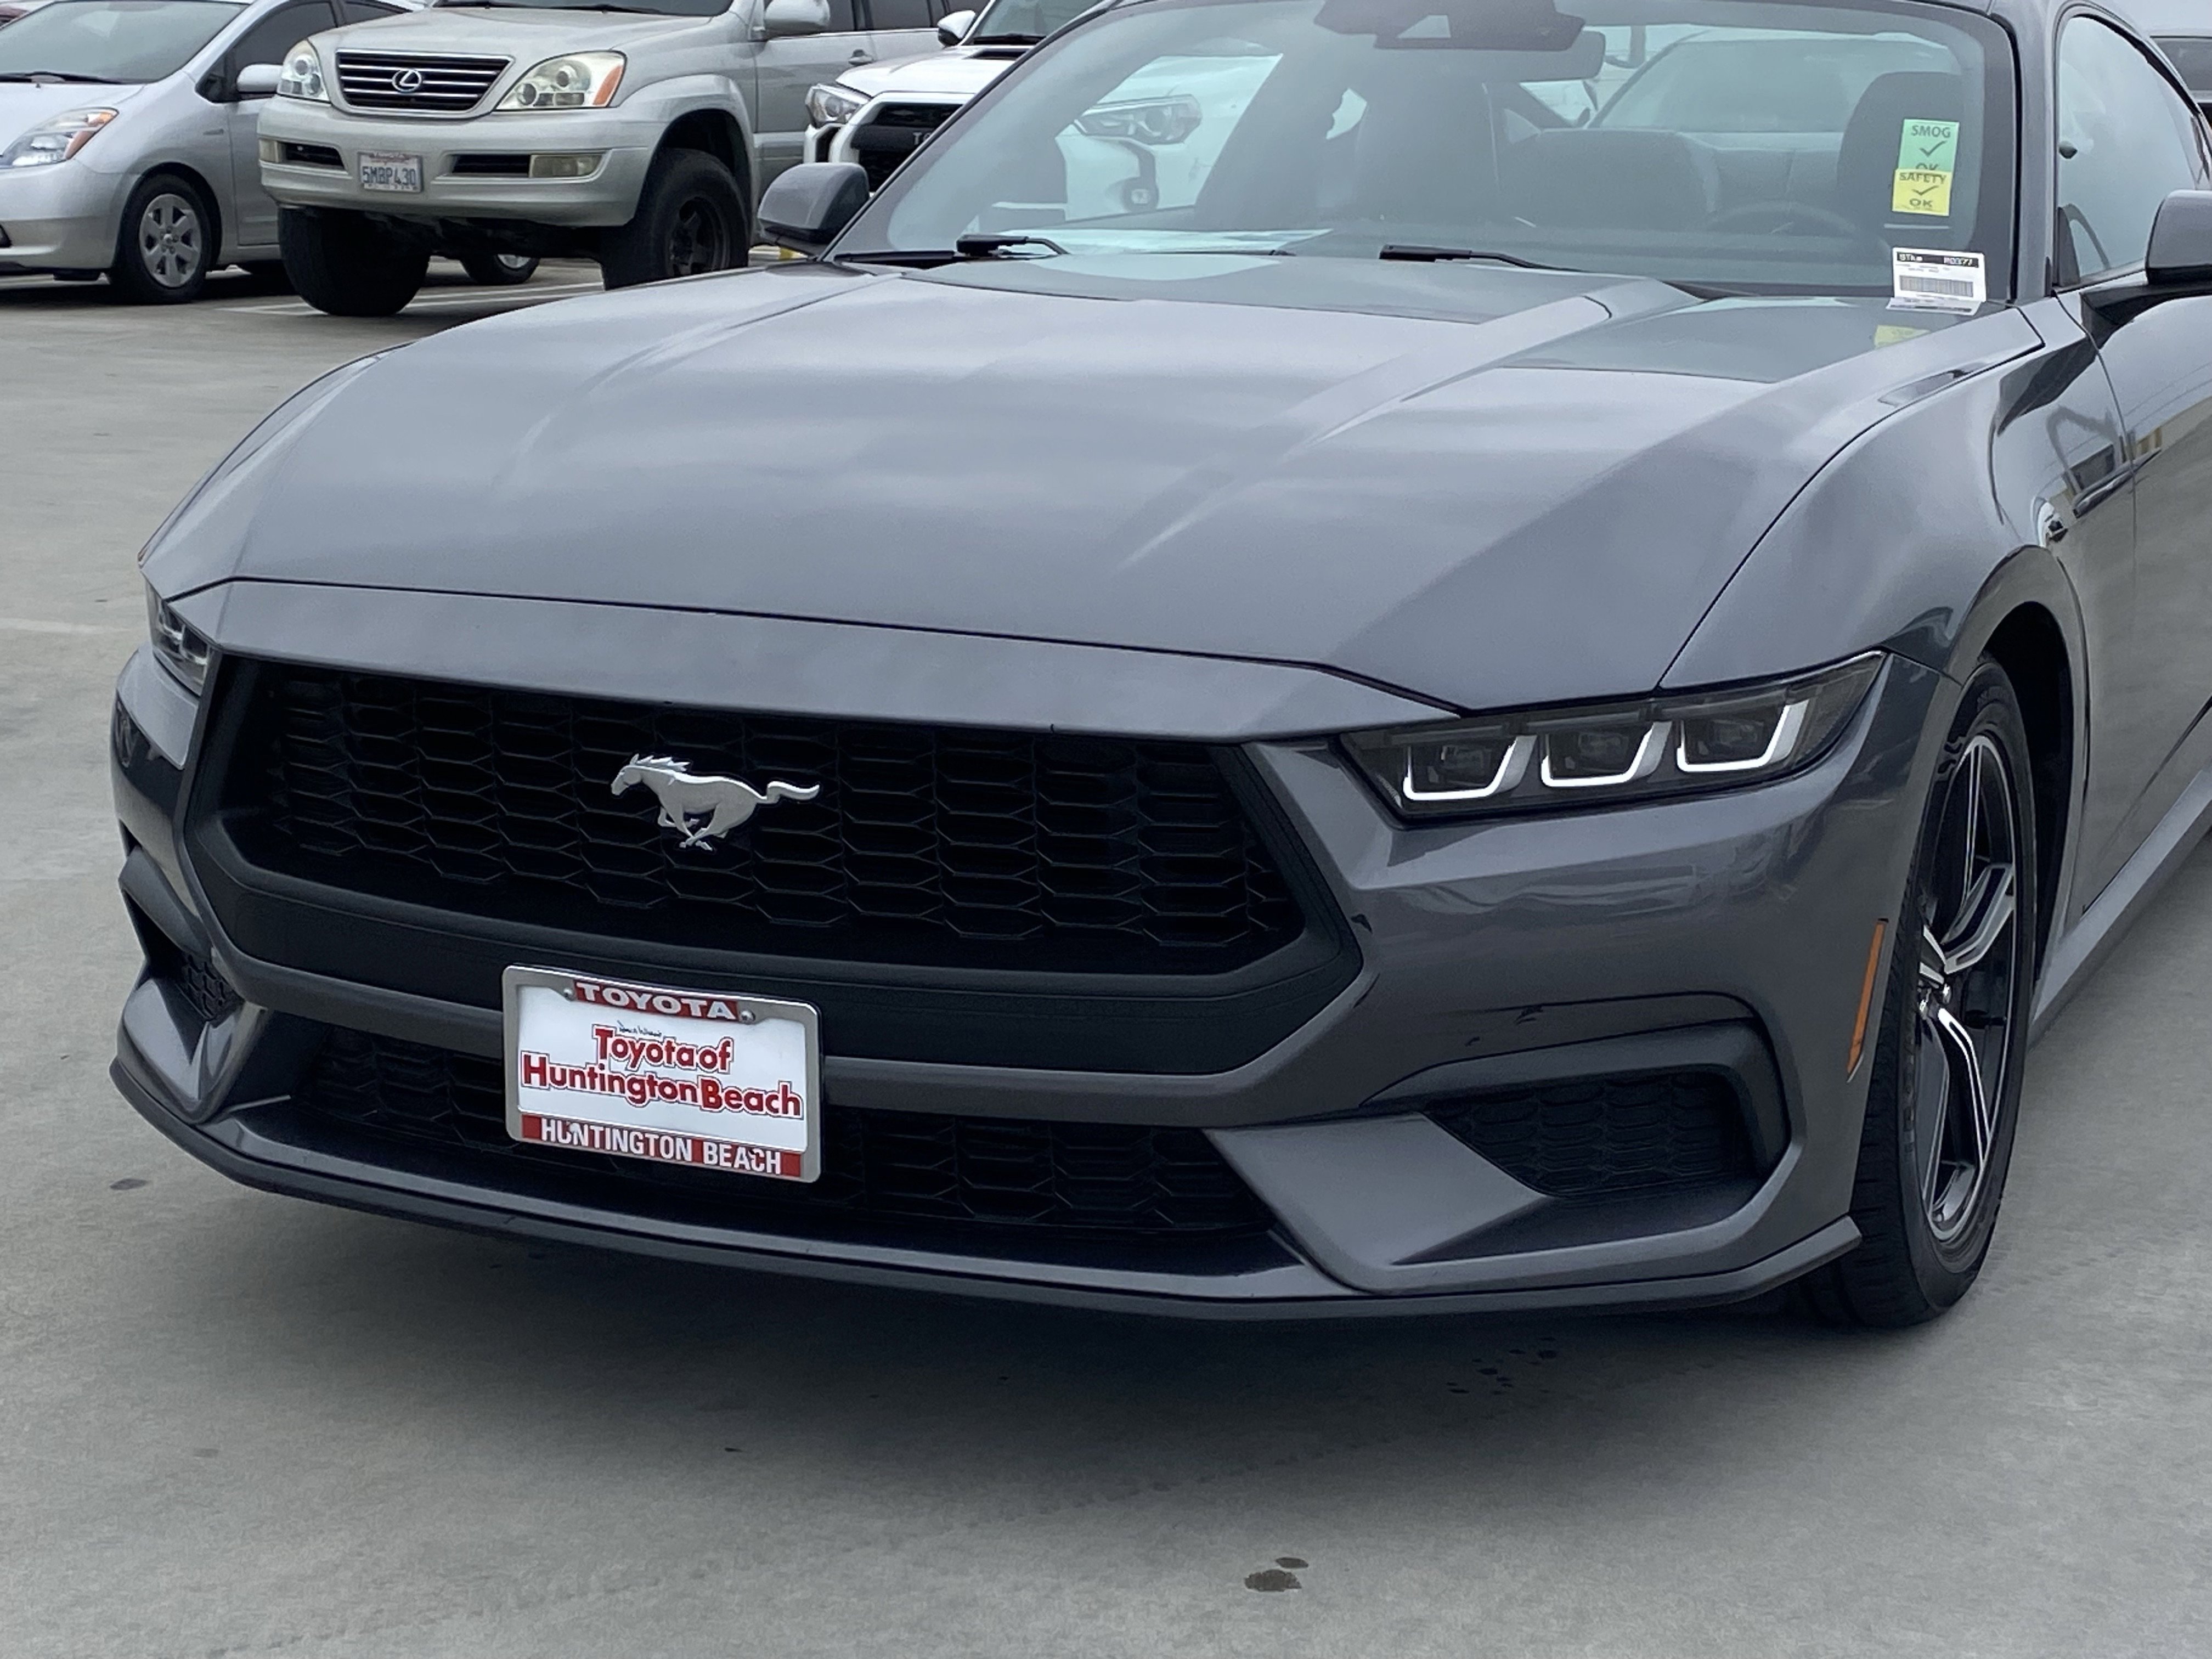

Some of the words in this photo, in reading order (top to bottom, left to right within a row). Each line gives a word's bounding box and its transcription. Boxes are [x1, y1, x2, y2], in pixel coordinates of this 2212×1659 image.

[1911, 125, 1951, 138] SMOG
[1899, 172, 1947, 184] SAFETY
[1909, 198, 1933, 208] OK
[577, 983, 736, 1020] TOYOTA
[594, 1028, 695, 1069] Toyota
[698, 1039, 732, 1071] of
[522, 1053, 698, 1105] Huntington
[699, 1077, 802, 1117] Beach
[541, 1118, 693, 1163] HUNTINGTON
[702, 1141, 782, 1175] BEACH
